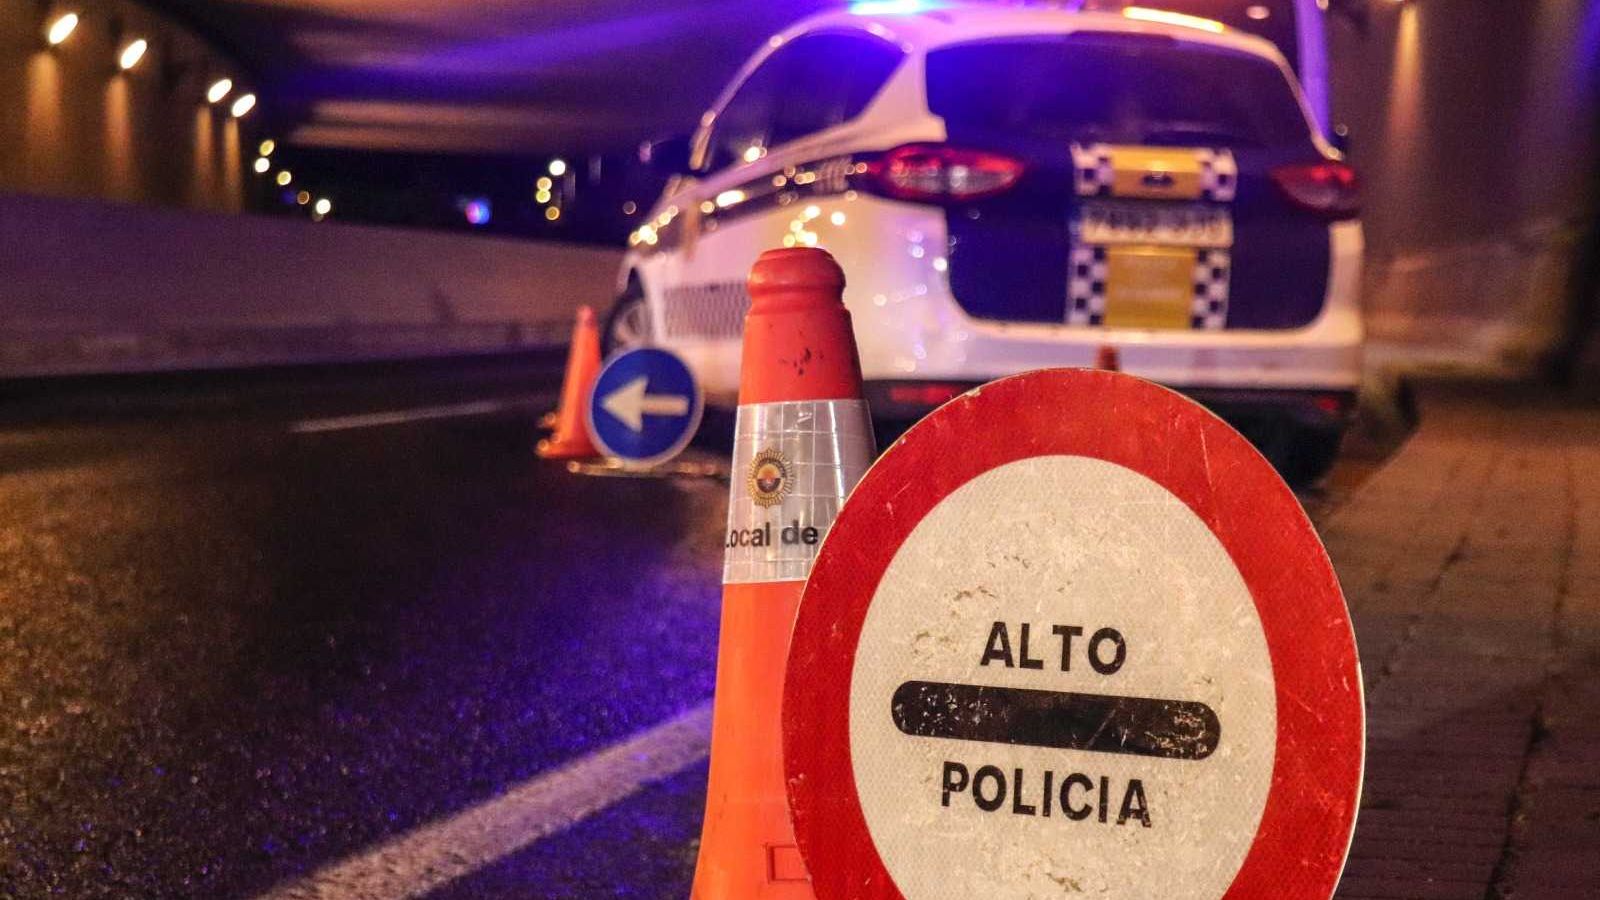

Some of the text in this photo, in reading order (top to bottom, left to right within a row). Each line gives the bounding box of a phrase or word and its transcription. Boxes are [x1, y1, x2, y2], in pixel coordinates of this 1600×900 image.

[725, 519, 819, 548] ocal de
[980, 620, 1127, 675] ALTO
[941, 760, 1152, 828] POLICIA
